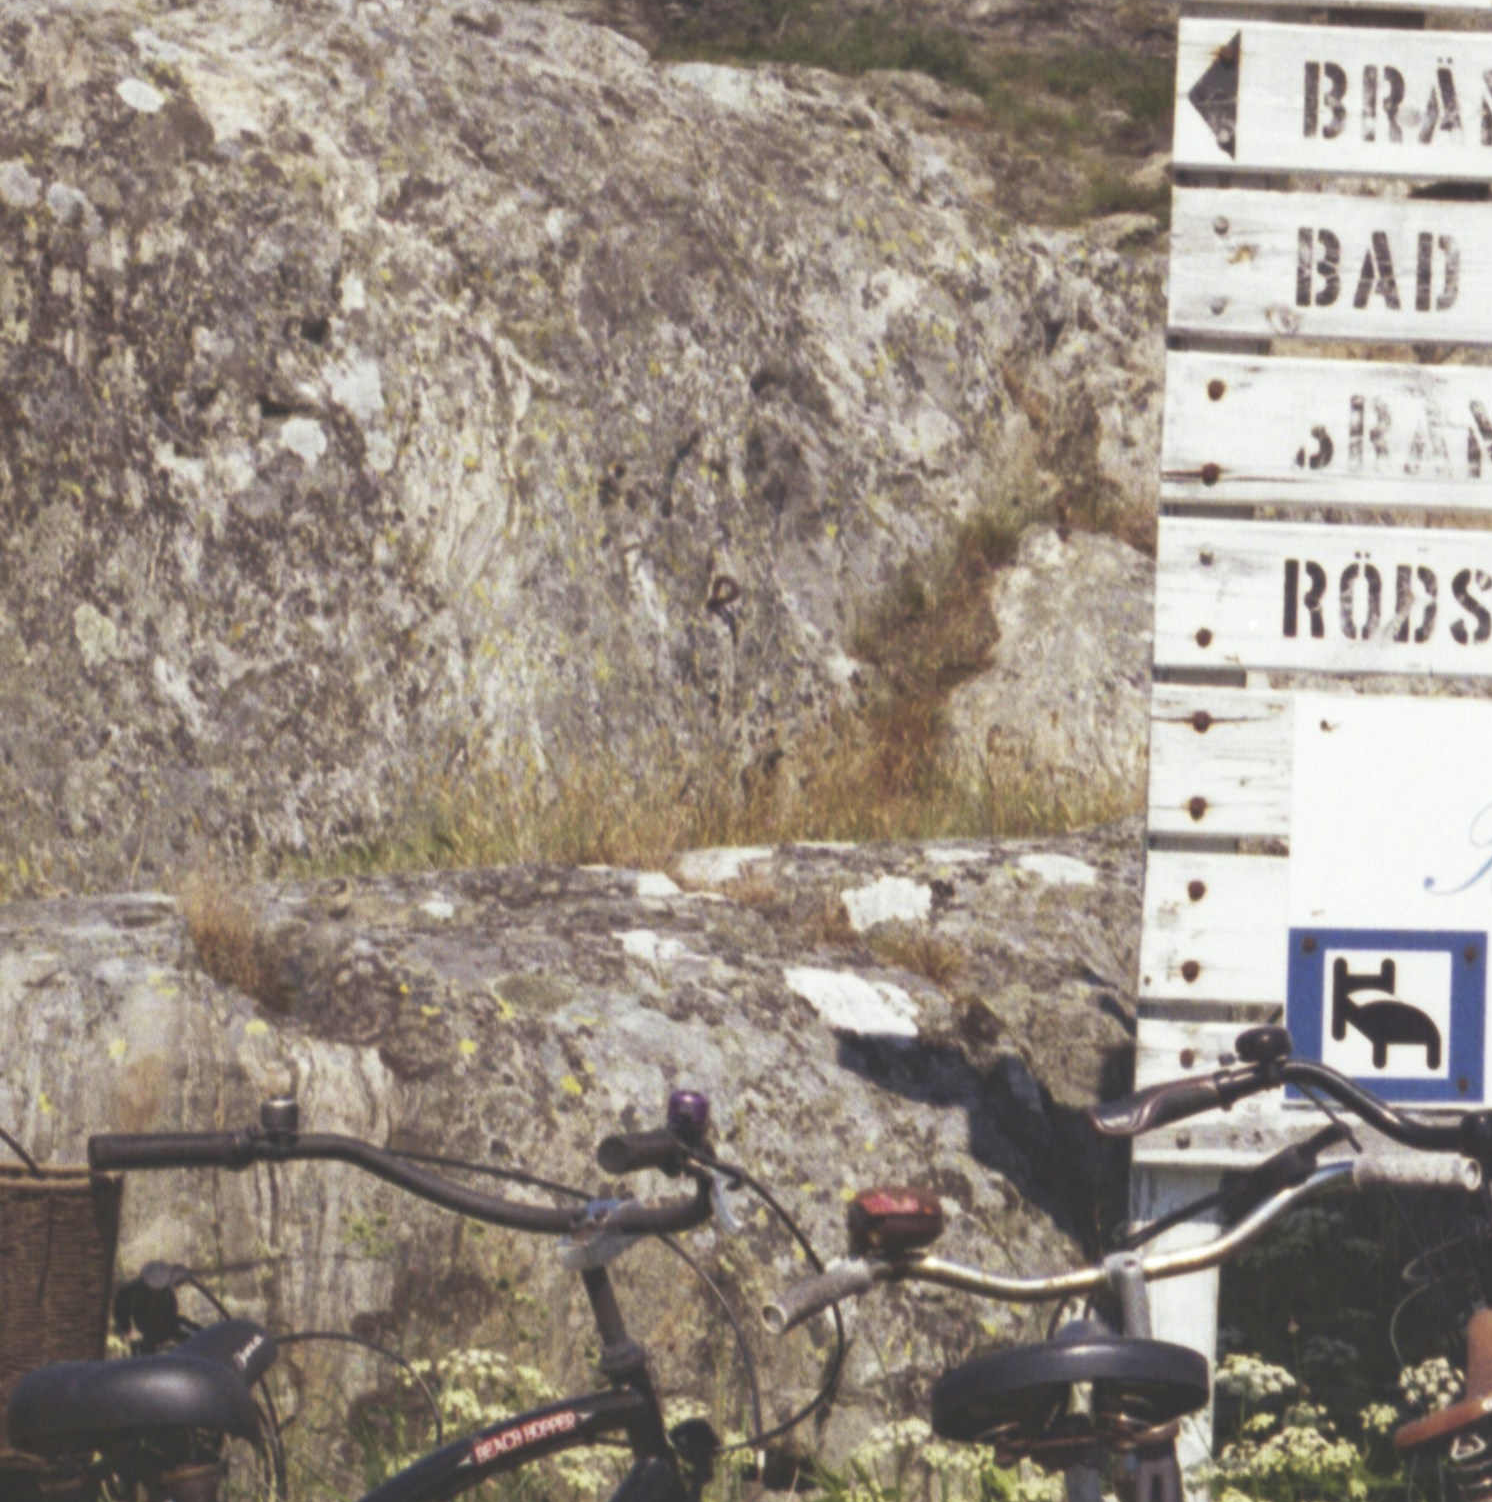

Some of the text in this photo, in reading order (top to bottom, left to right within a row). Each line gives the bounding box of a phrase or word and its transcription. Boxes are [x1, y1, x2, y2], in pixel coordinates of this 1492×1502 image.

[1295, 227, 1461, 312] BAD
[475, 1411, 576, 1465] BEACH HOPPER
